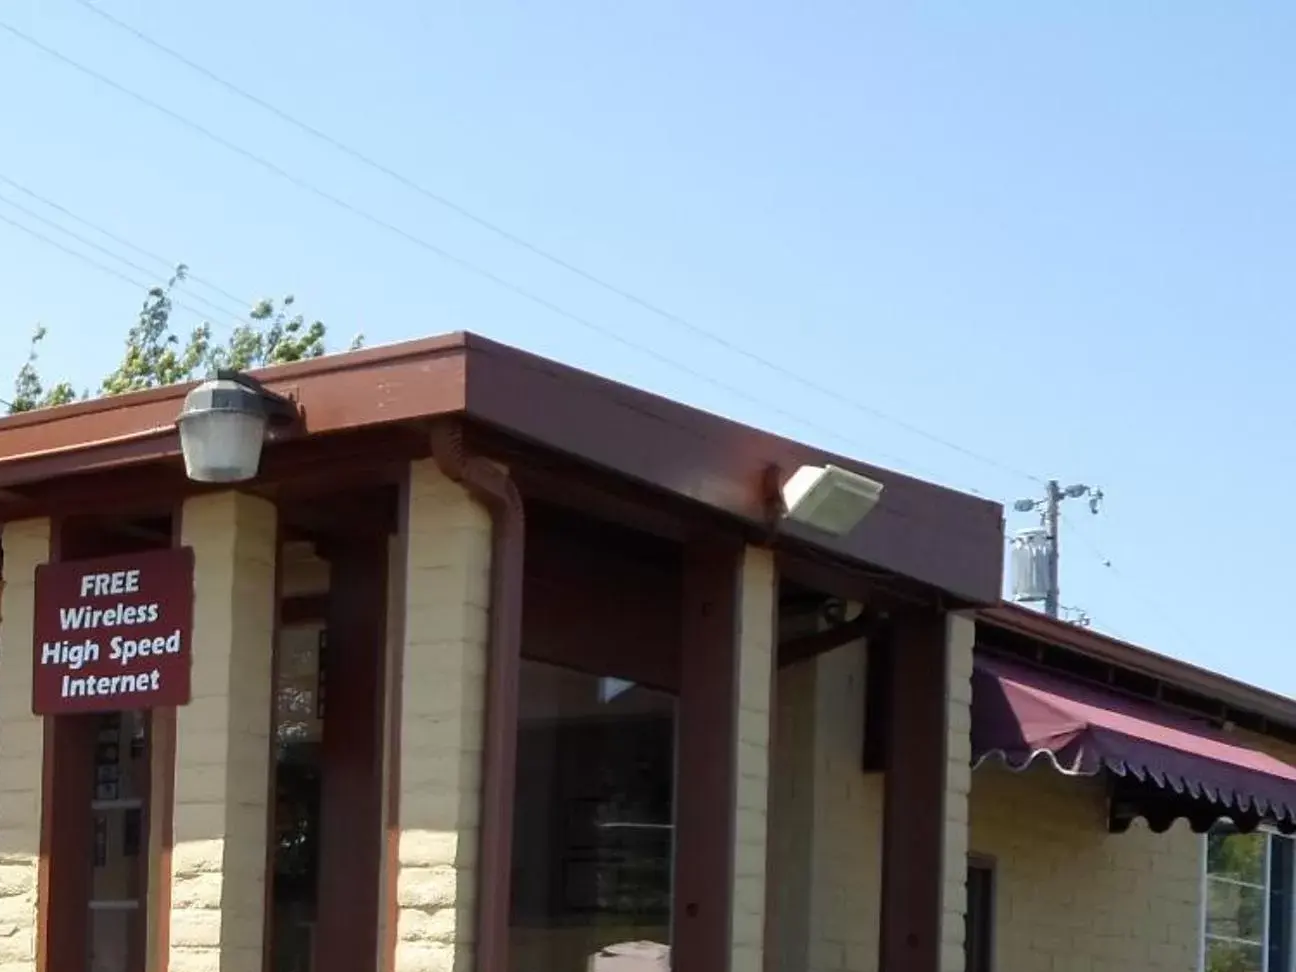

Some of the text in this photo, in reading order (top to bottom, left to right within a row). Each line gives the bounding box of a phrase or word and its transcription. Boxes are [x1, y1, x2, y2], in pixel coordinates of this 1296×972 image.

[80, 570, 140, 597] FREE
[60, 602, 158, 630] Wireless
[41, 630, 181, 669] High Speed
[61, 669, 160, 697] Internet
